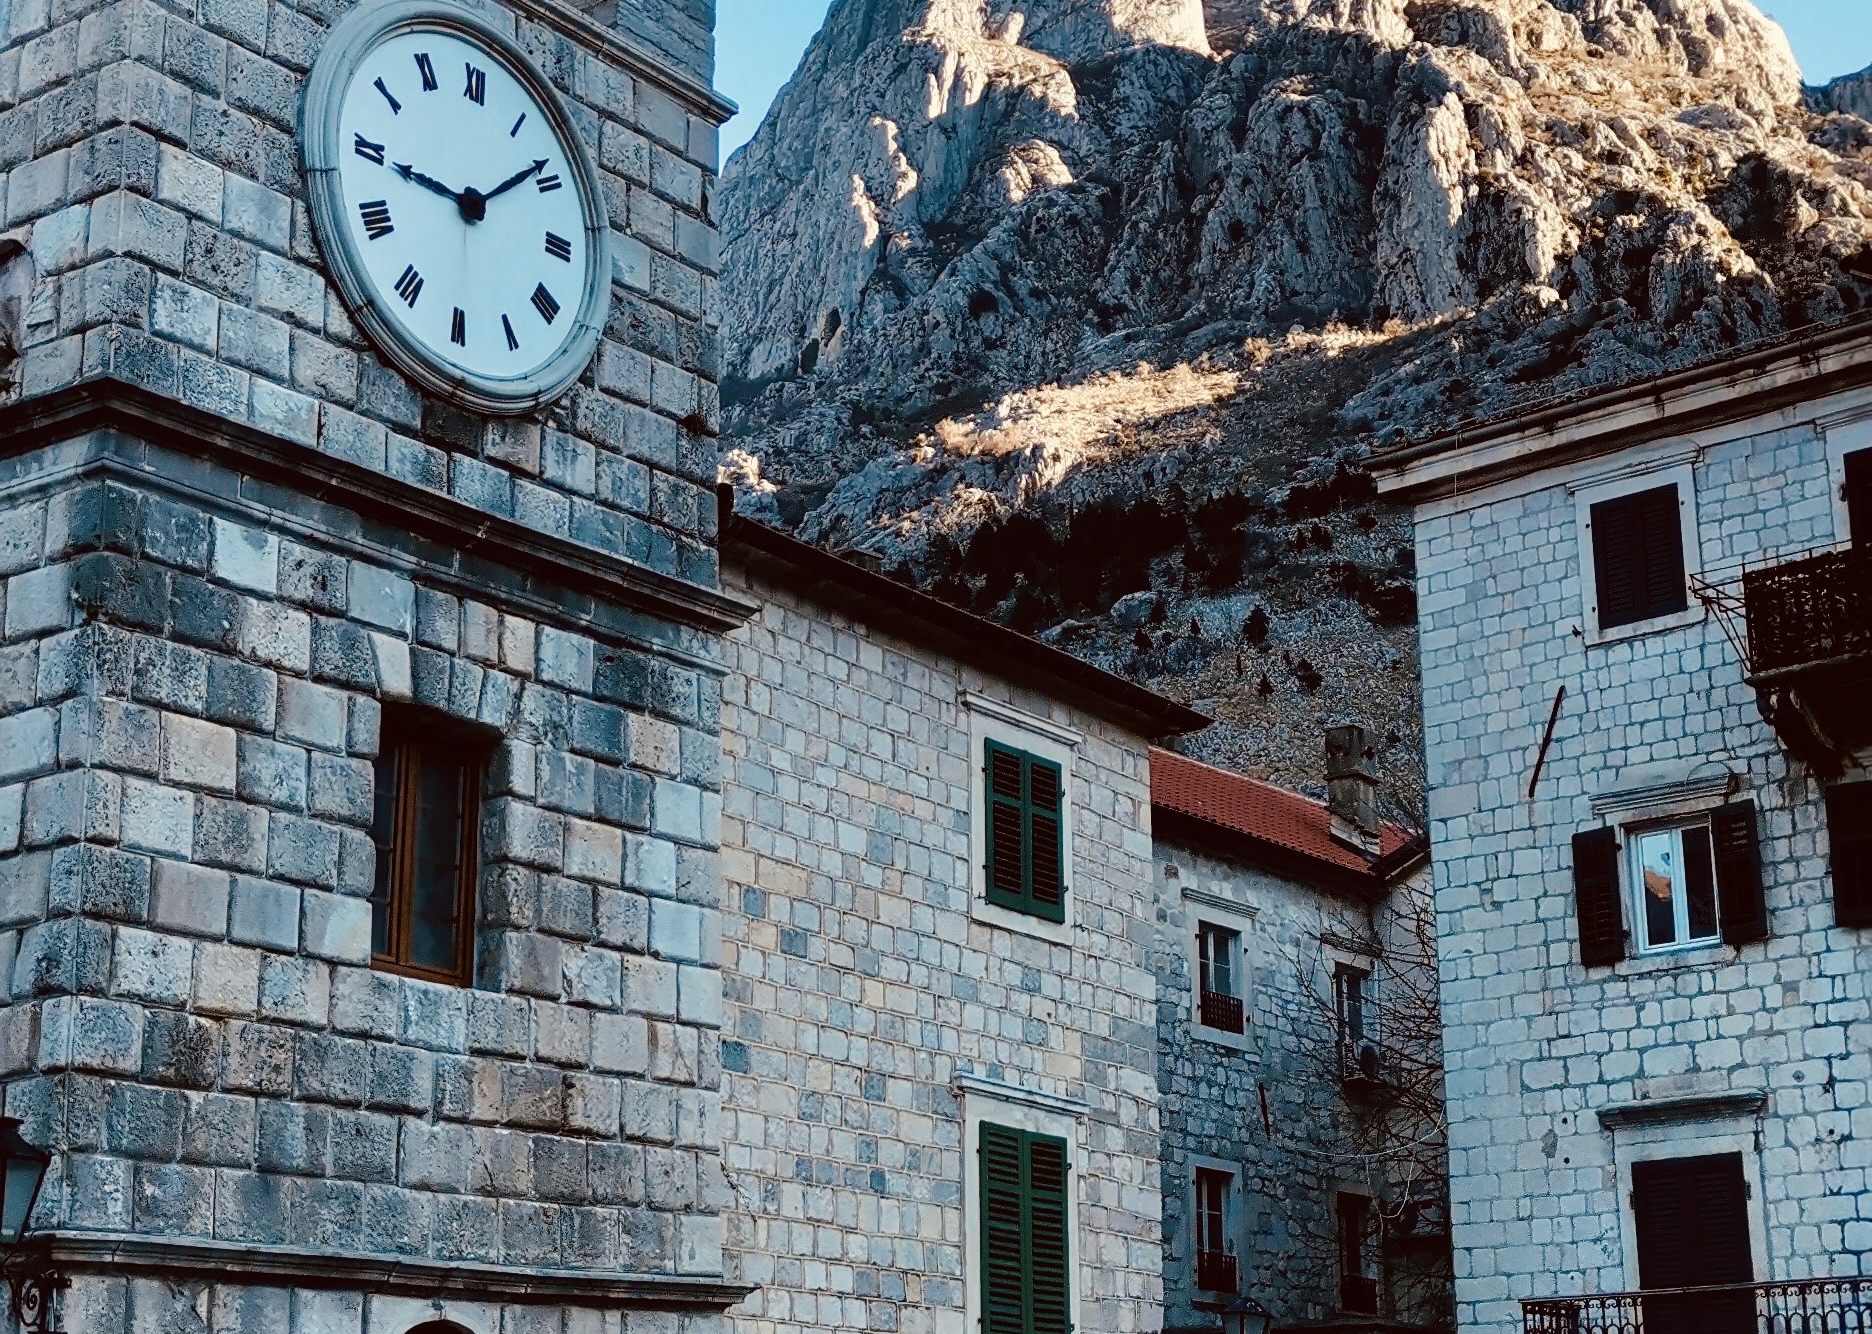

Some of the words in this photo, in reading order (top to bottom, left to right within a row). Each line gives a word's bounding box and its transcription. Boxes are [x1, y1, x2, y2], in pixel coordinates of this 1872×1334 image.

[413, 53, 439, 92] XI
[464, 62, 486, 107] XII
[373, 77, 401, 115] X
[509, 112, 527, 139] I
[353, 132, 386, 167] IX
[536, 174, 563, 194] II
[359, 200, 395, 242] VIII
[545, 231, 572, 264] III
[394, 264, 425, 309] VII
[451, 307, 466, 348] VI
[501, 313, 520, 352] V
